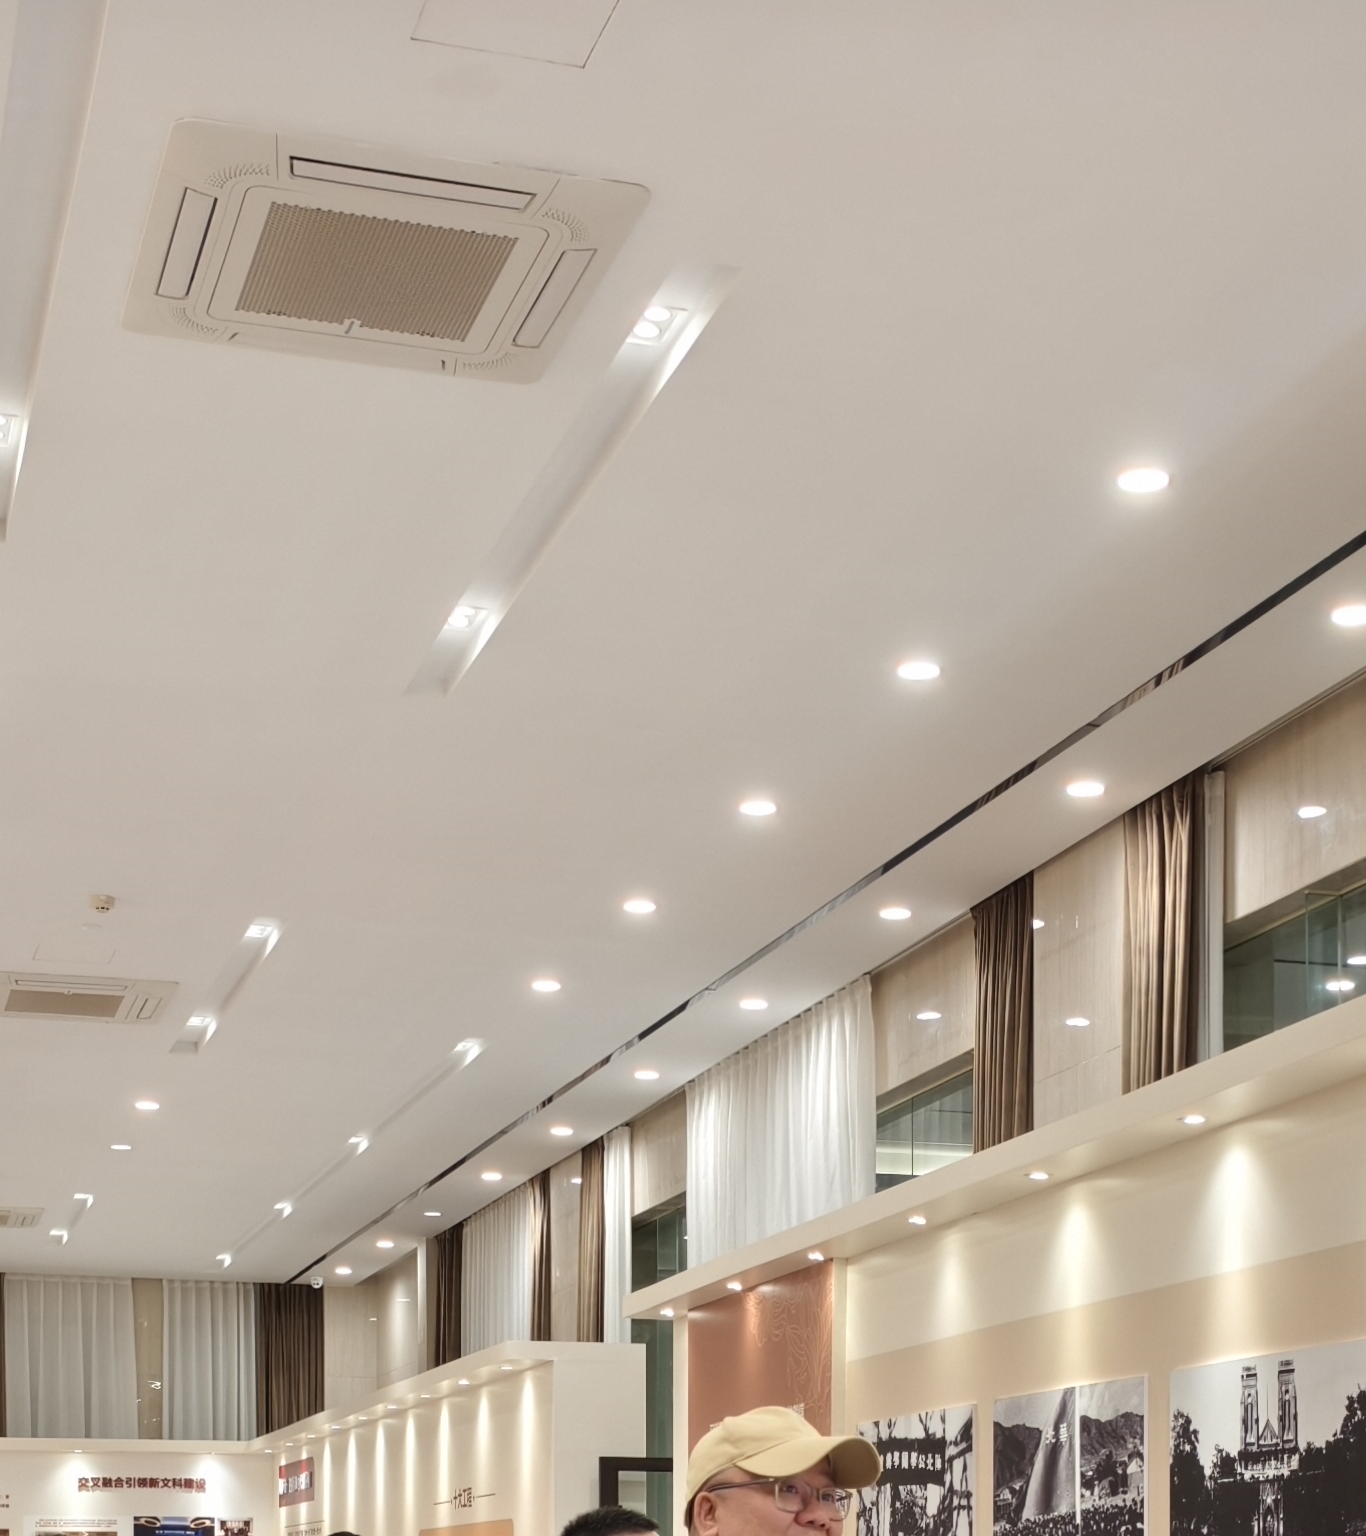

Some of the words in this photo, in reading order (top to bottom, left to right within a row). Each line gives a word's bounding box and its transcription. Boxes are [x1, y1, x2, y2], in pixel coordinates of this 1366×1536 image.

[78, 1476, 207, 1491] 交叉融合引领新文科建设
